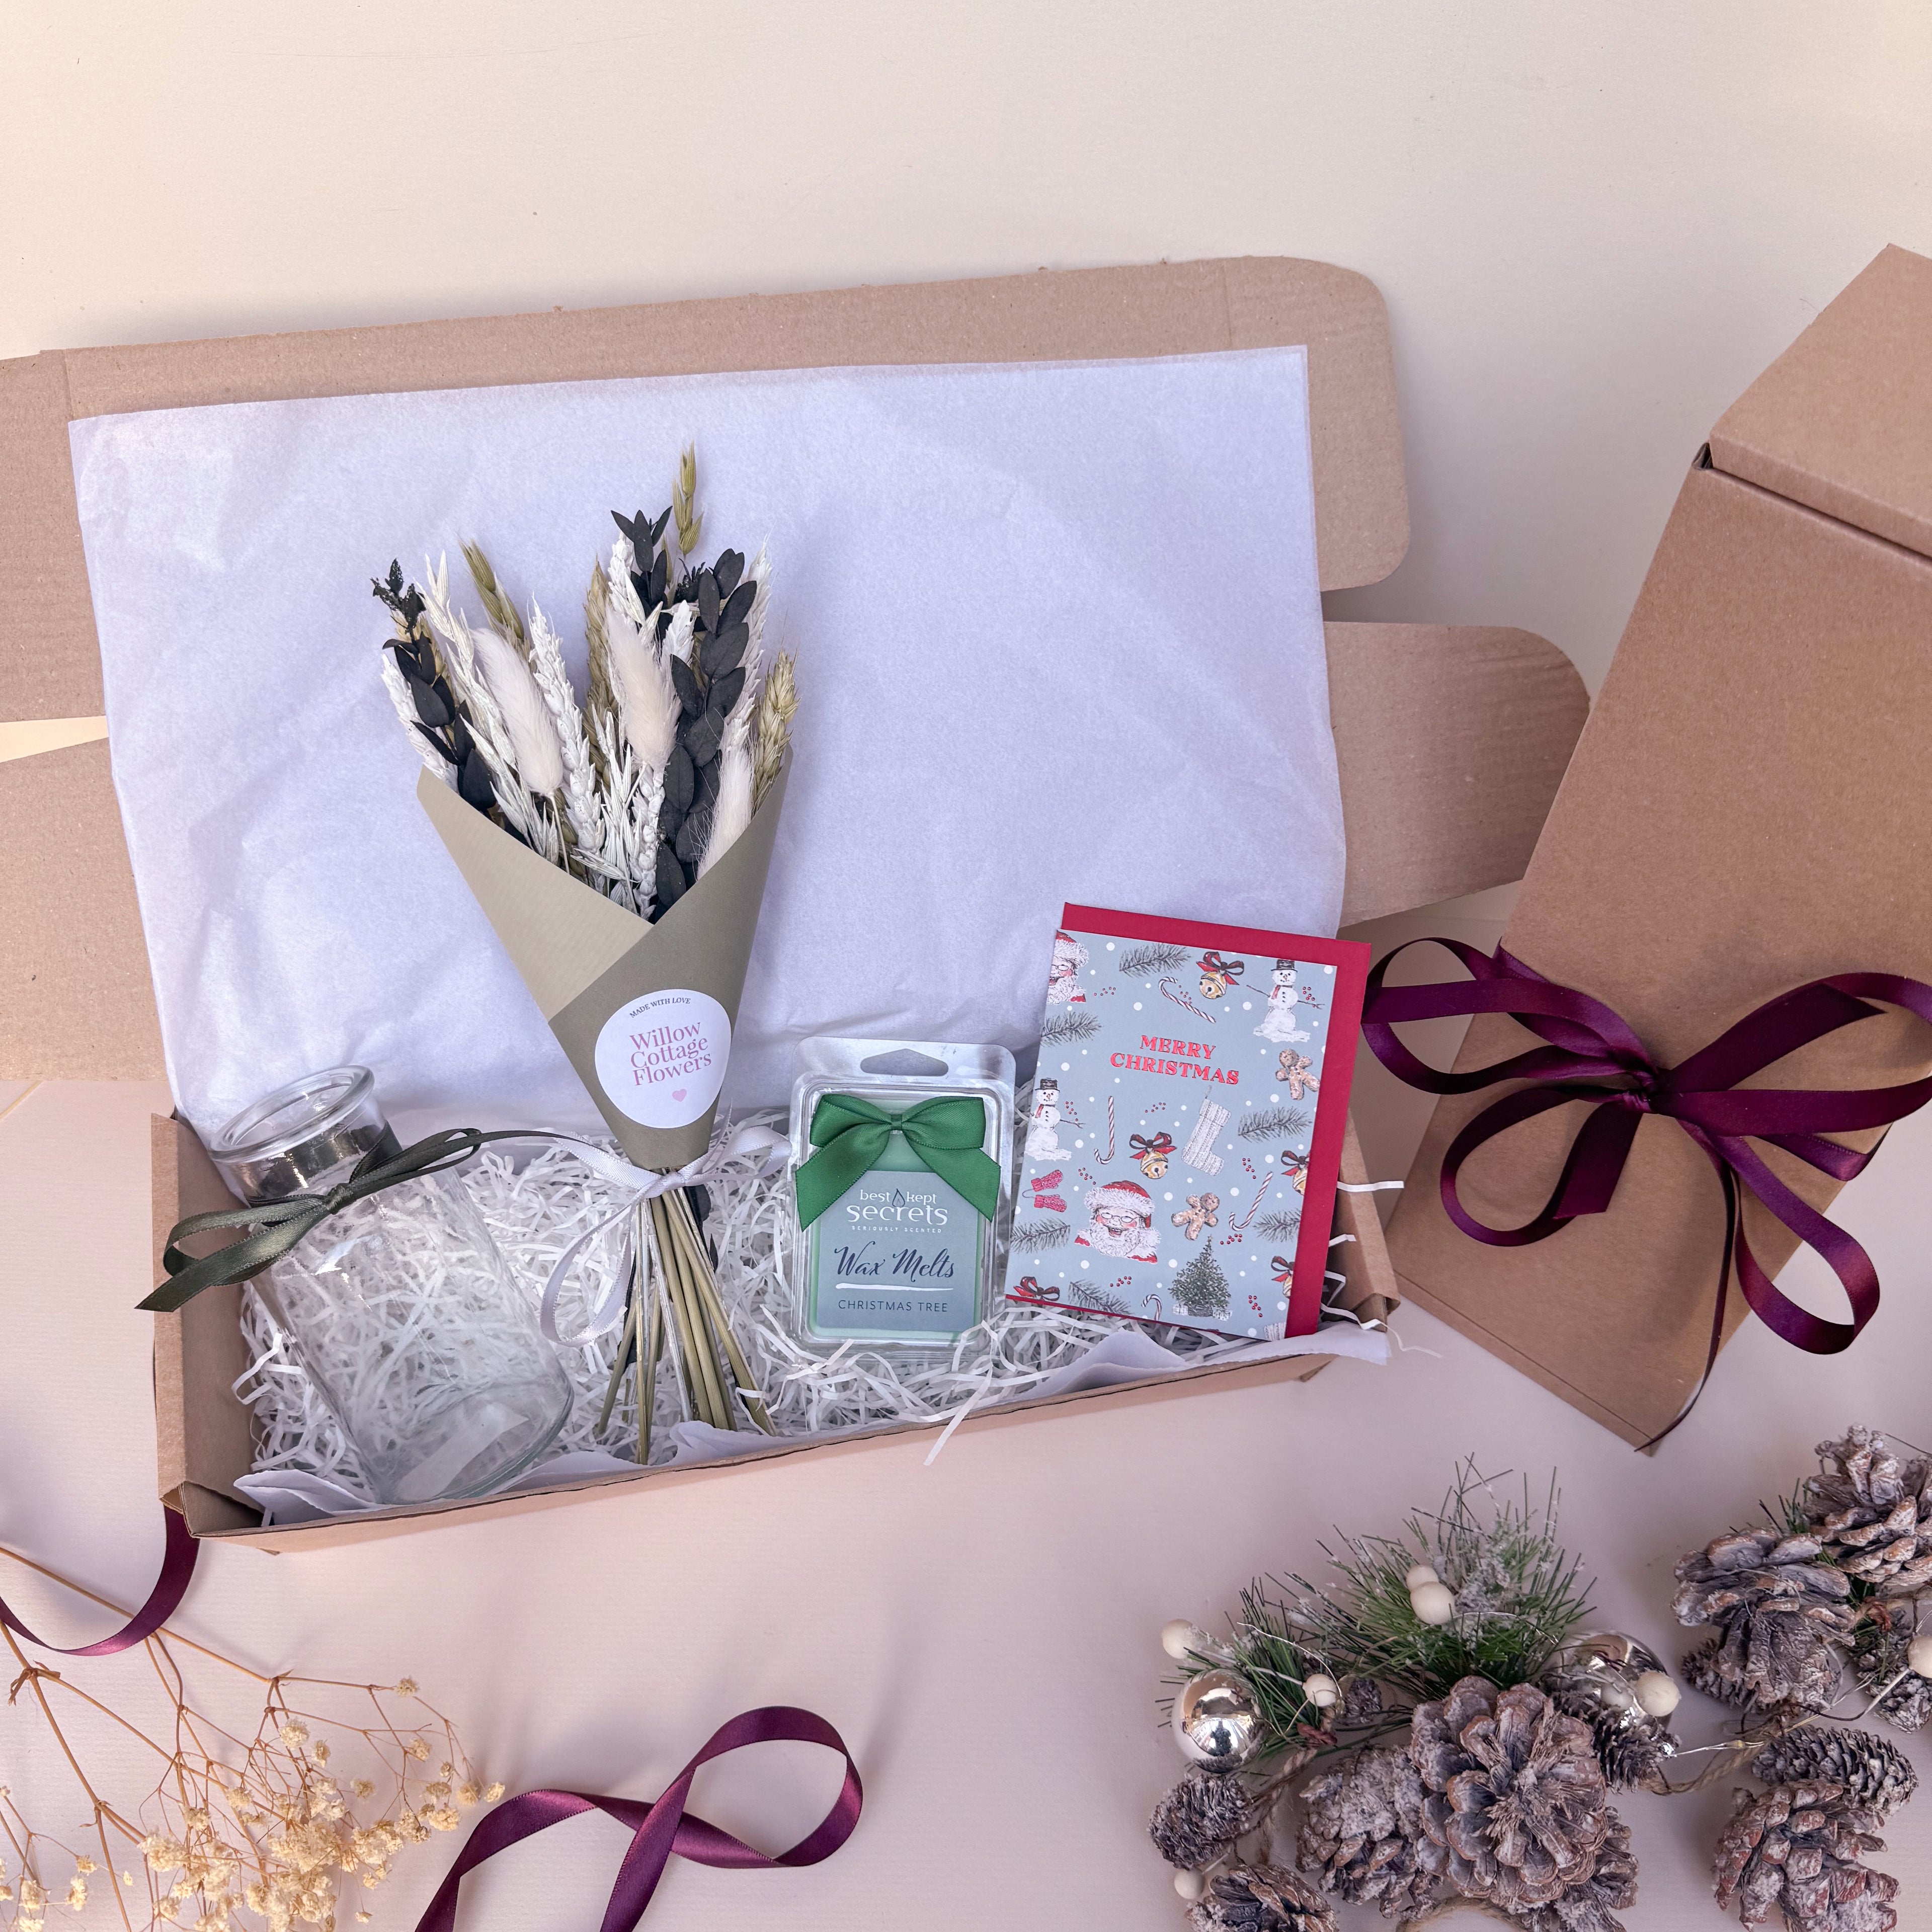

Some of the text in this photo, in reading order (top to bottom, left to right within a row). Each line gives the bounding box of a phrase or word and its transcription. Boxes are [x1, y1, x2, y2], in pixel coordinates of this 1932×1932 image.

[629, 1004, 650, 1018] MADE
[651, 998, 670, 1007] WITH
[629, 1022, 701, 1050] Willow
[1140, 1035, 1216, 1059] MERRY
[631, 1037, 708, 1068] Cottage
[632, 1054, 711, 1086] Flowers
[1110, 1053, 1239, 1085] CHRISTMAS
[860, 1189, 937, 1205] best kept
[846, 1205, 948, 1225] secrets
[834, 1241, 954, 1282] Wax Melts
[838, 1300, 947, 1312] CHRISTMAS TREE
